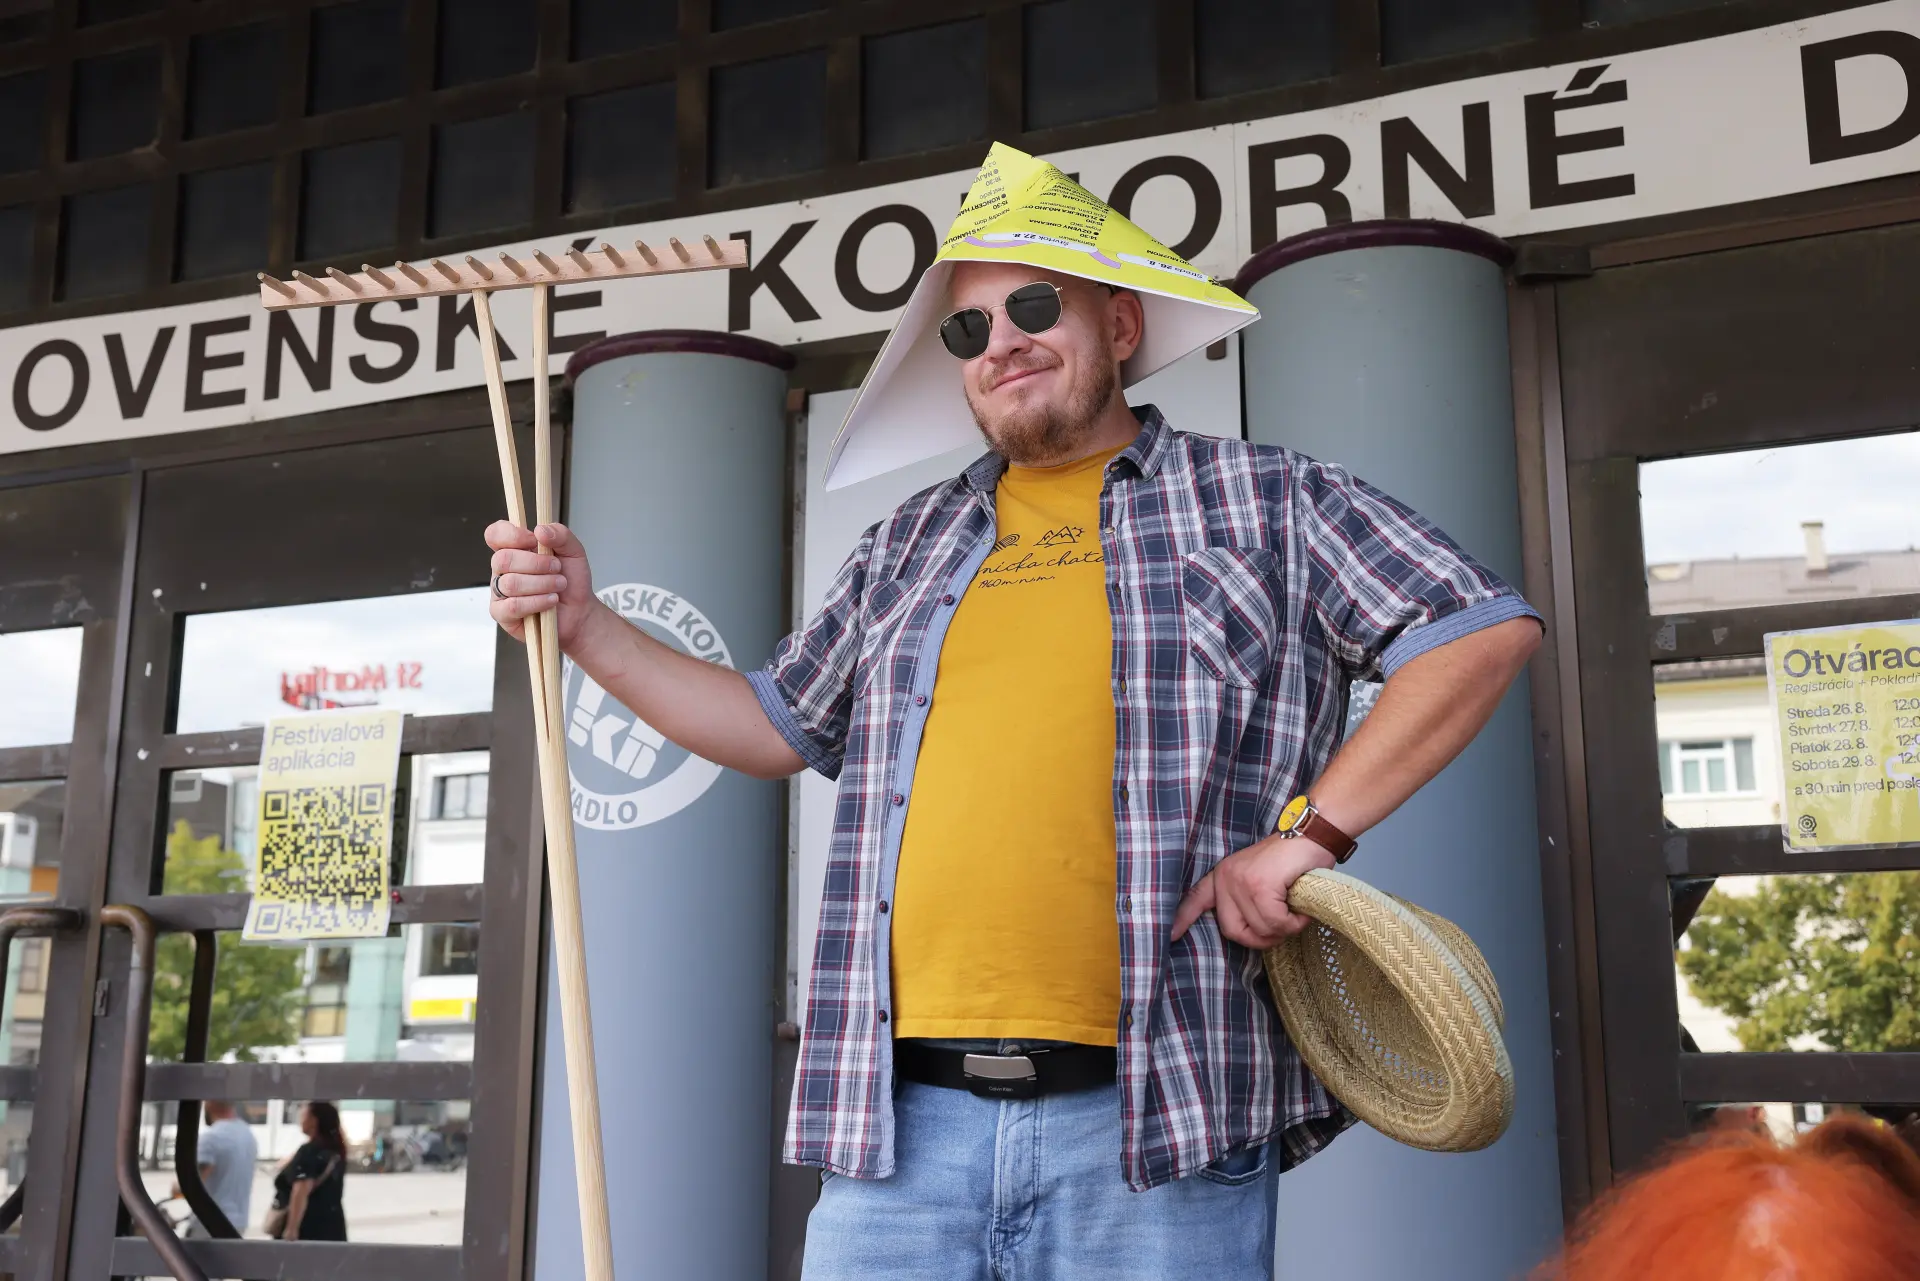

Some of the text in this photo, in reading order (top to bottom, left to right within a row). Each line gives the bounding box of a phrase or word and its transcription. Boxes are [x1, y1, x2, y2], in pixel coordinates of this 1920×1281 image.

[729, 63, 1636, 332] KOORNÉ
[971, 195, 1001, 212] KONCERT
[1062, 224, 1092, 235] OZVENY
[1079, 233, 1098, 241] 14:30
[1783, 642, 1920, 678] Otvárac
[1785, 675, 1854, 695] Registrácia
[1787, 706, 1831, 720] Streda
[1832, 703, 1853, 716] 26.
[1855, 701, 1867, 714] 8.
[271, 718, 385, 746] Festivalová
[1788, 721, 1837, 737] Štvrtok
[1839, 720, 1858, 733] 27.
[1859, 719, 1872, 731] 8.
[1790, 739, 1832, 755] Piatok
[1833, 738, 1855, 751] 28.
[1856, 737, 1869, 750] 8.
[267, 747, 355, 777] aplikácia
[1792, 757, 1840, 772] Sobota
[1842, 755, 1863, 769] 29.
[1864, 754, 1877, 767] 8.
[1795, 785, 1802, 796] a
[1804, 782, 1824, 795] 30
[1825, 781, 1851, 794] min
[1854, 778, 1885, 795] pred
[572, 787, 638, 824] ADLO
